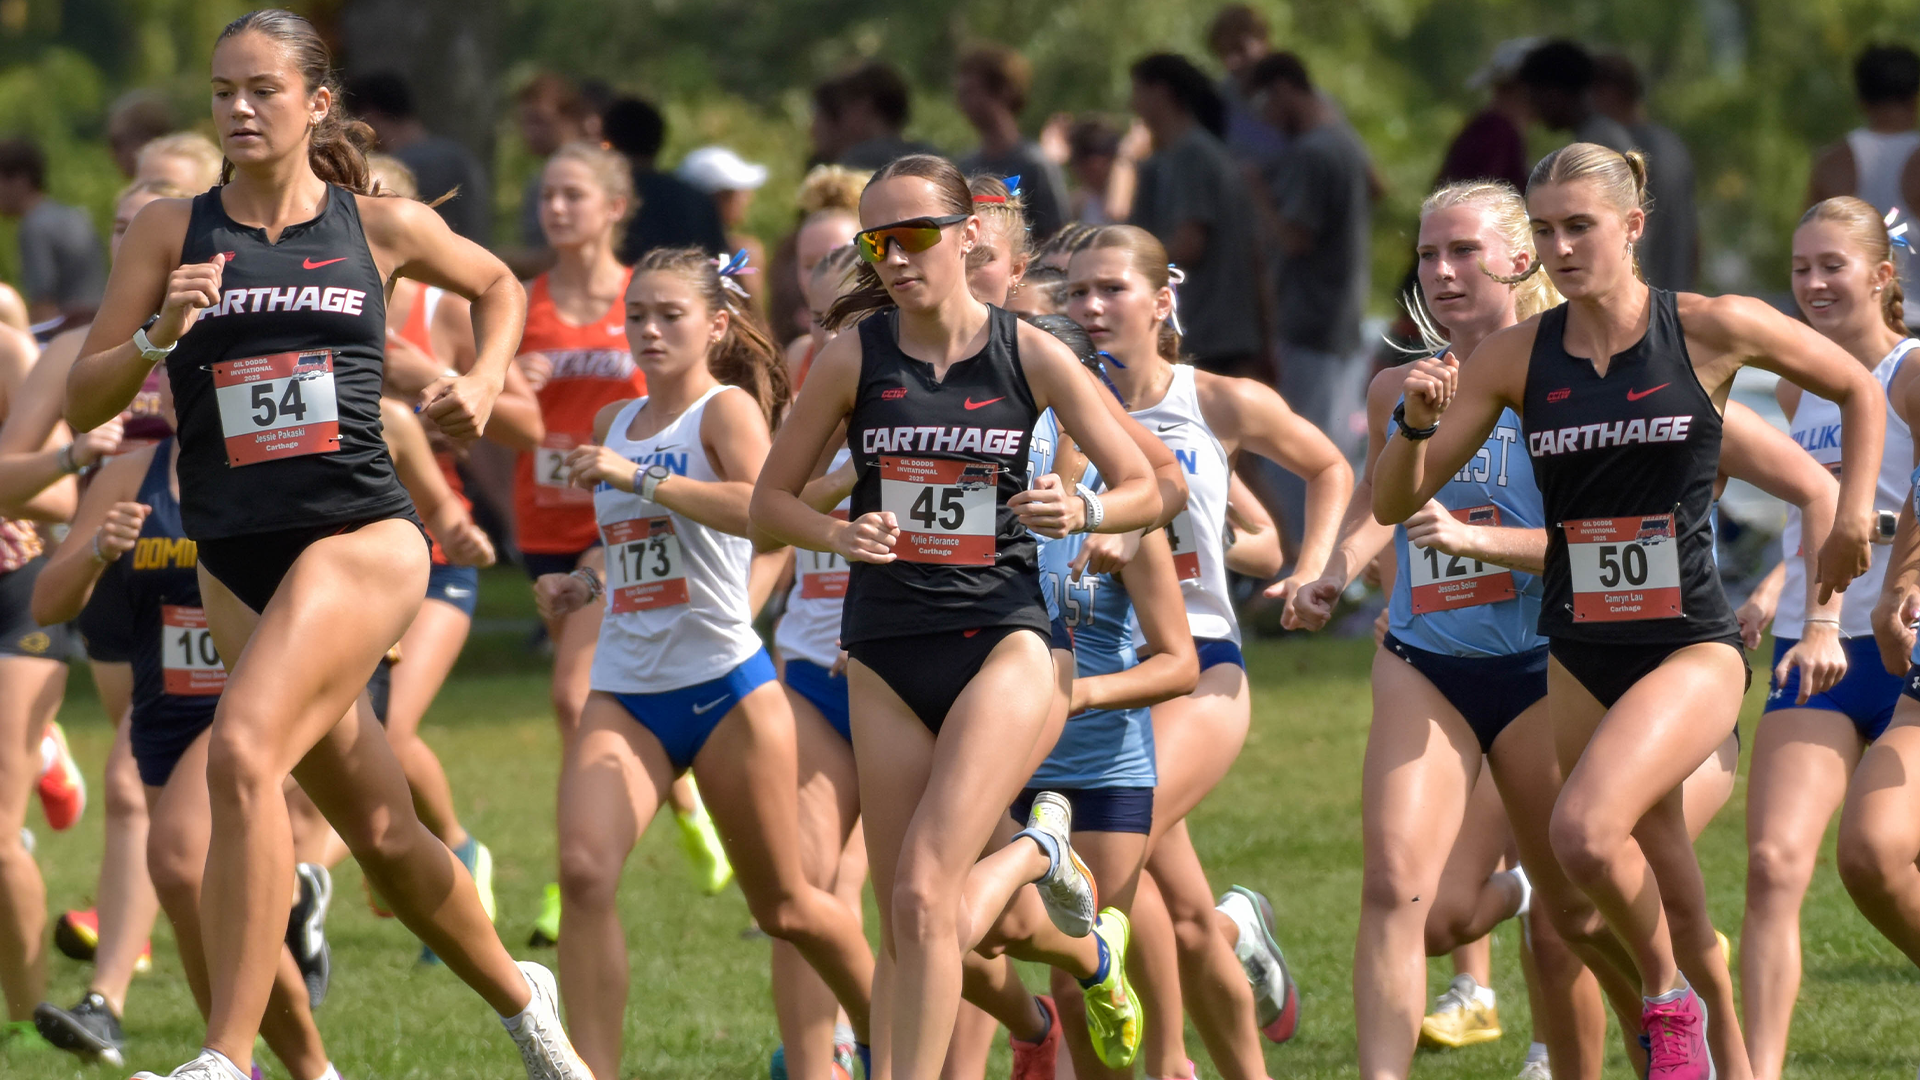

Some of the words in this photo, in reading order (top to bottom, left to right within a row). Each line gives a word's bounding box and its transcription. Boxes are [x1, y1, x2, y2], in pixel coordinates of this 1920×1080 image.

[198, 286, 367, 321] ARTHAGE
[230, 365, 273, 376] INVITATIONAL
[245, 358, 268, 367] DODDS
[251, 380, 307, 427] 54
[255, 432, 277, 444] Jessie
[278, 428, 305, 440] Pakaski
[863, 426, 1024, 455] CARTHAGE
[1529, 415, 1693, 457] CARTHAGE
[897, 467, 938, 475] INVITATIONAL
[910, 486, 965, 530] 45
[1580, 527, 1617, 535] INVITATIONAL
[911, 535, 928, 545] Kylie
[928, 536, 960, 546] Florance
[618, 541, 671, 583] 173
[1599, 543, 1648, 588] 50
[1437, 582, 1460, 594] Jessica
[1460, 580, 1478, 591] Solar
[1604, 594, 1629, 604] Camryn
[1630, 593, 1644, 601] Lau
